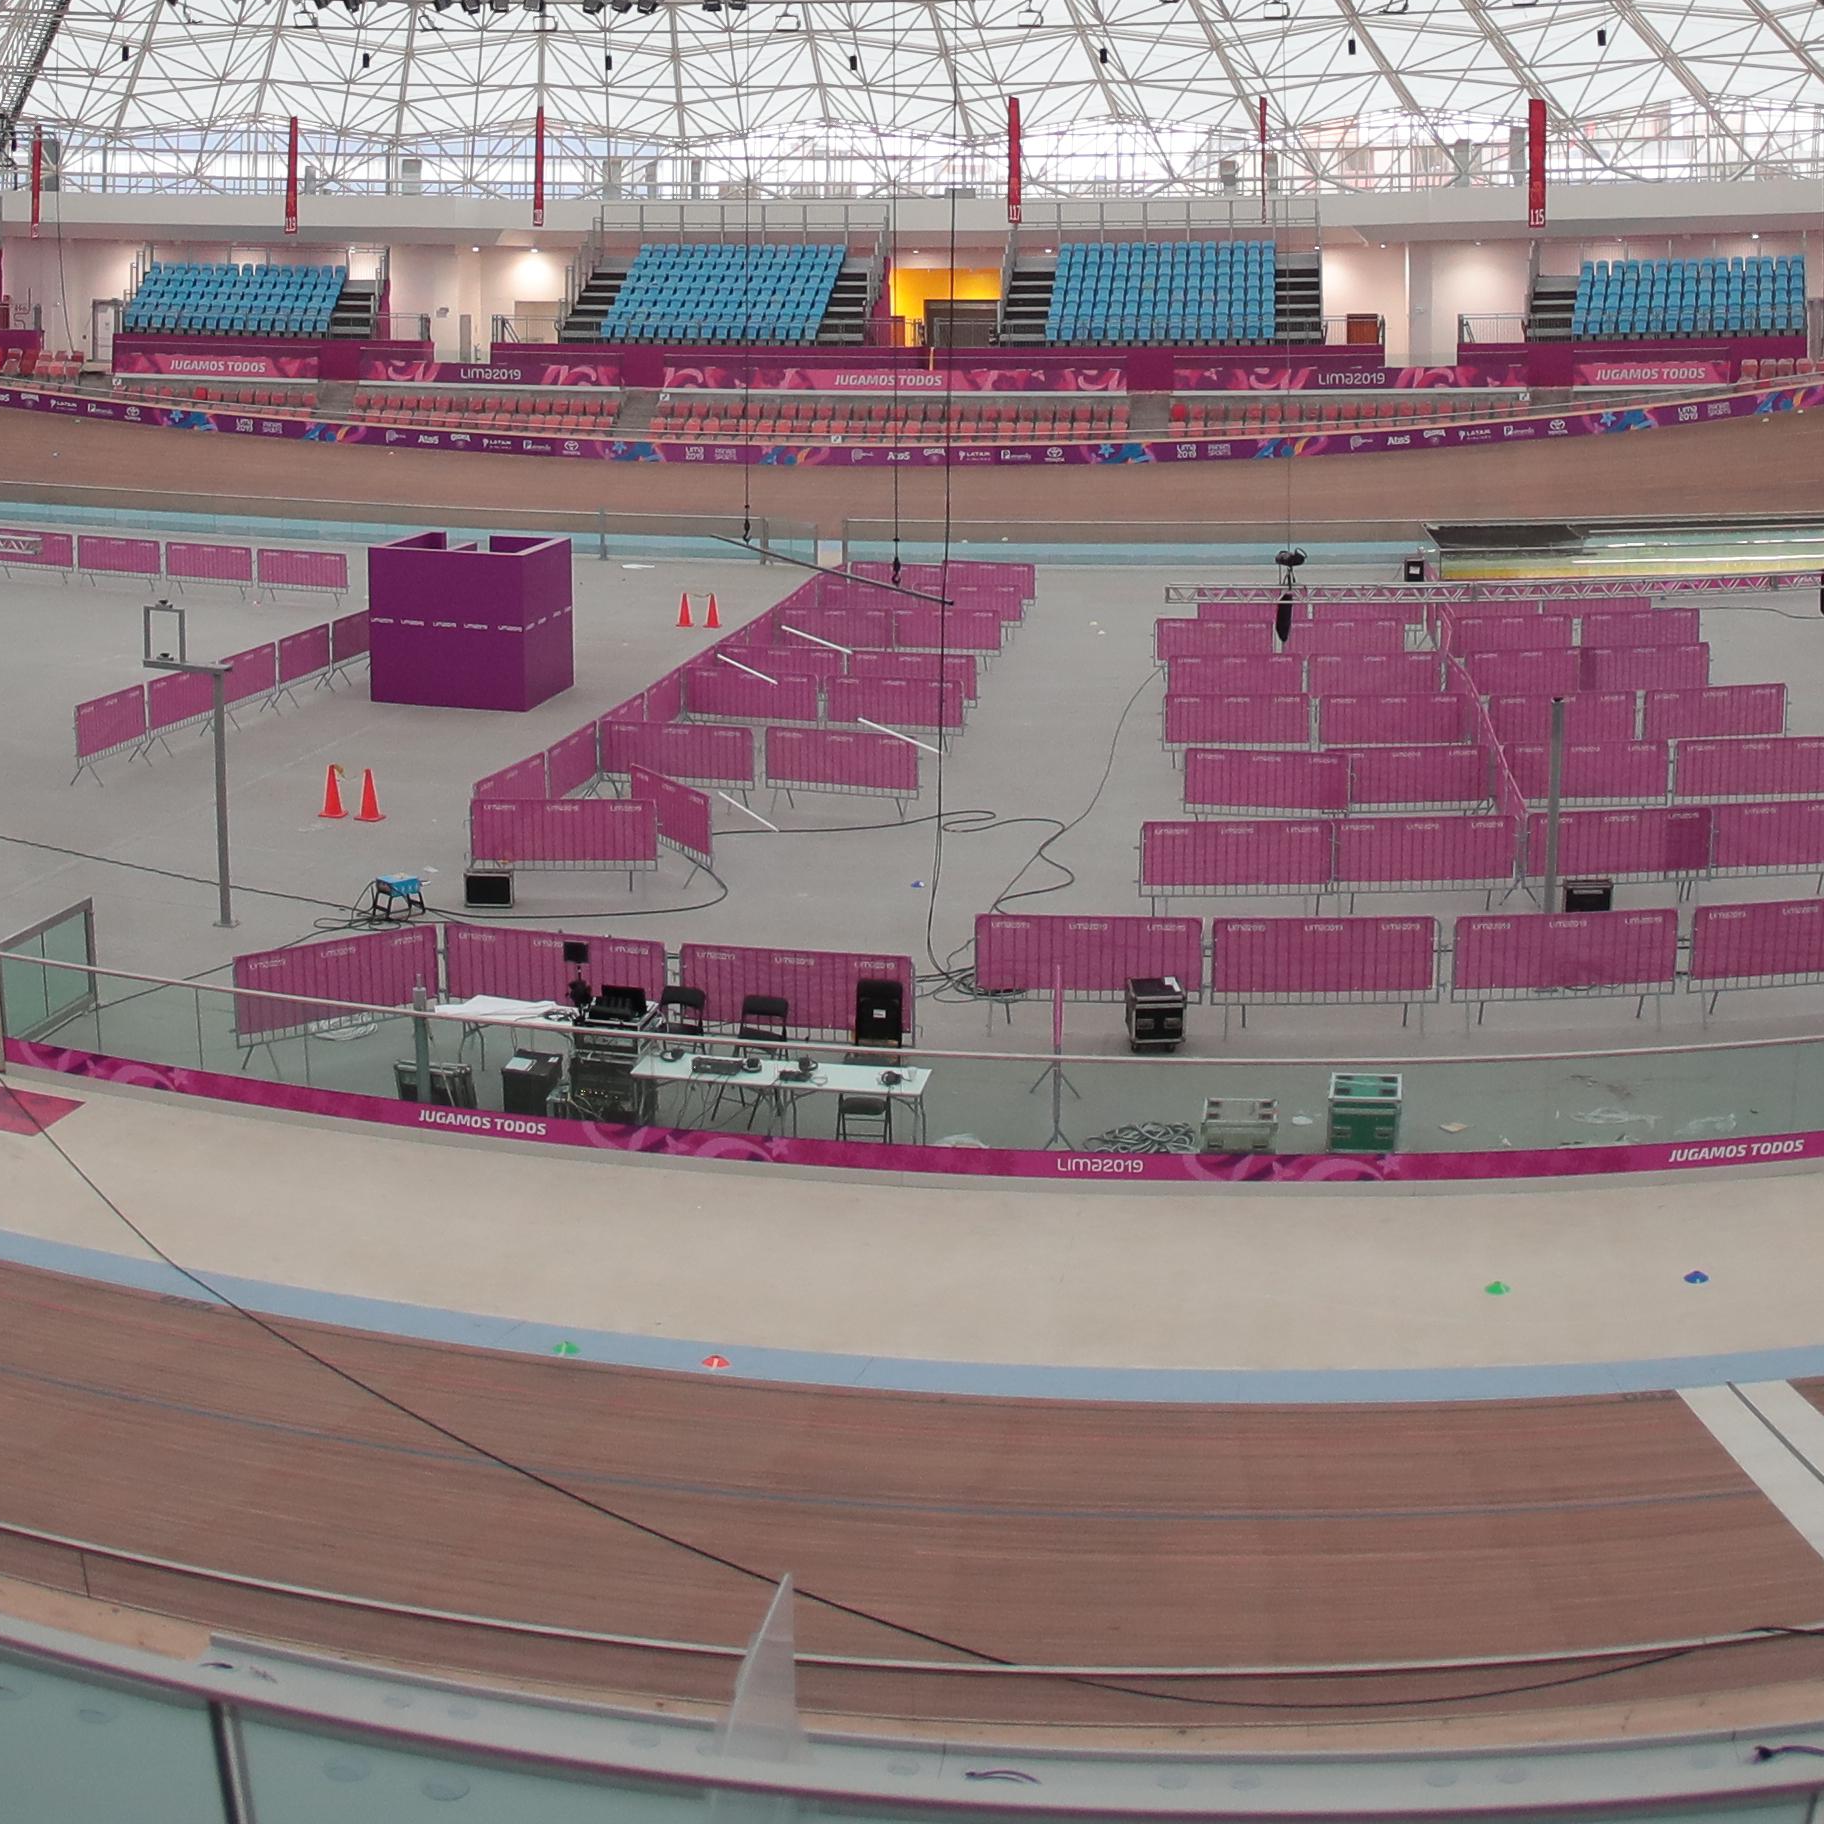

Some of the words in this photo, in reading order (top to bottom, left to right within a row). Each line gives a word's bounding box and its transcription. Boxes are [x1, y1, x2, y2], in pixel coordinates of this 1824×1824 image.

[1529, 209, 1544, 225] 115
[170, 359, 225, 372] JUGAMOS
[227, 361, 266, 373] TODOS
[834, 374, 896, 386] JUGAMOS
[898, 375, 943, 386] TODOS
[1595, 368, 1659, 381] JUGAMOS
[1662, 367, 1706, 379] TODOS
[418, 1109, 491, 1129] JUGAMOS
[494, 1118, 547, 1135] TODOS
[1668, 1143, 1747, 1162] JUGAMOS
[1751, 1139, 1805, 1156] TODOS
